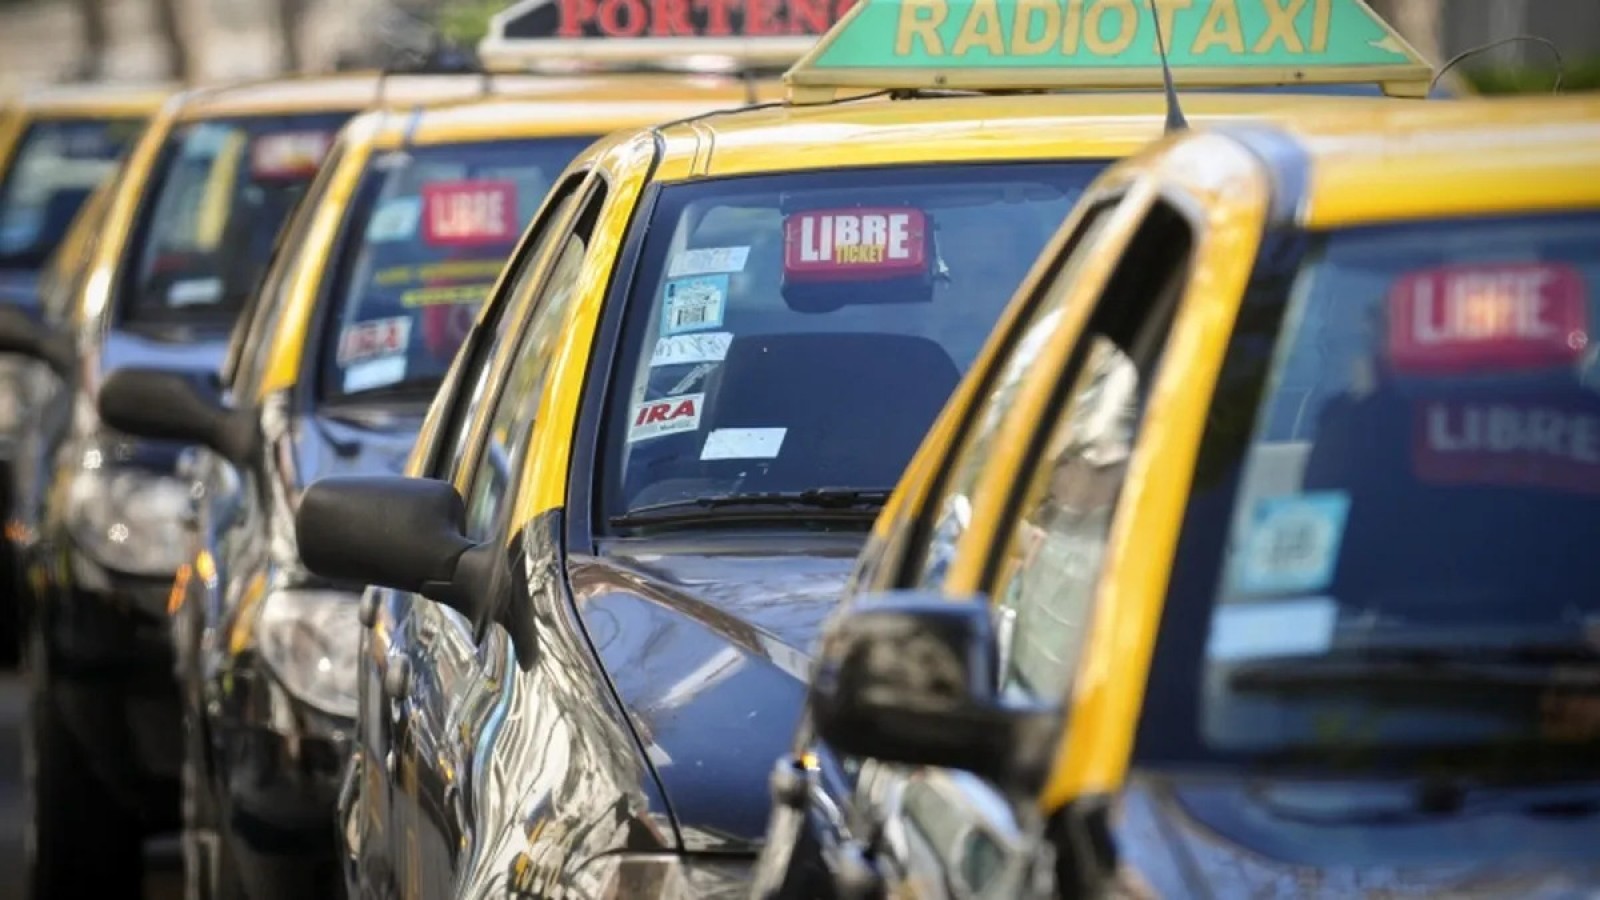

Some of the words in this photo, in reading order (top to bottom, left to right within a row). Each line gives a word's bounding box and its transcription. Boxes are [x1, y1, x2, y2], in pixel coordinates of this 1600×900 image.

[556, 0, 862, 37] PORTEN
[431, 191, 506, 237] LIBRE
[801, 213, 909, 262] LIBRE
[836, 243, 886, 264] TICKET
[1413, 268, 1558, 344] LIBRE
[634, 399, 695, 427] IRA
[1427, 402, 1600, 464] LIBRE
